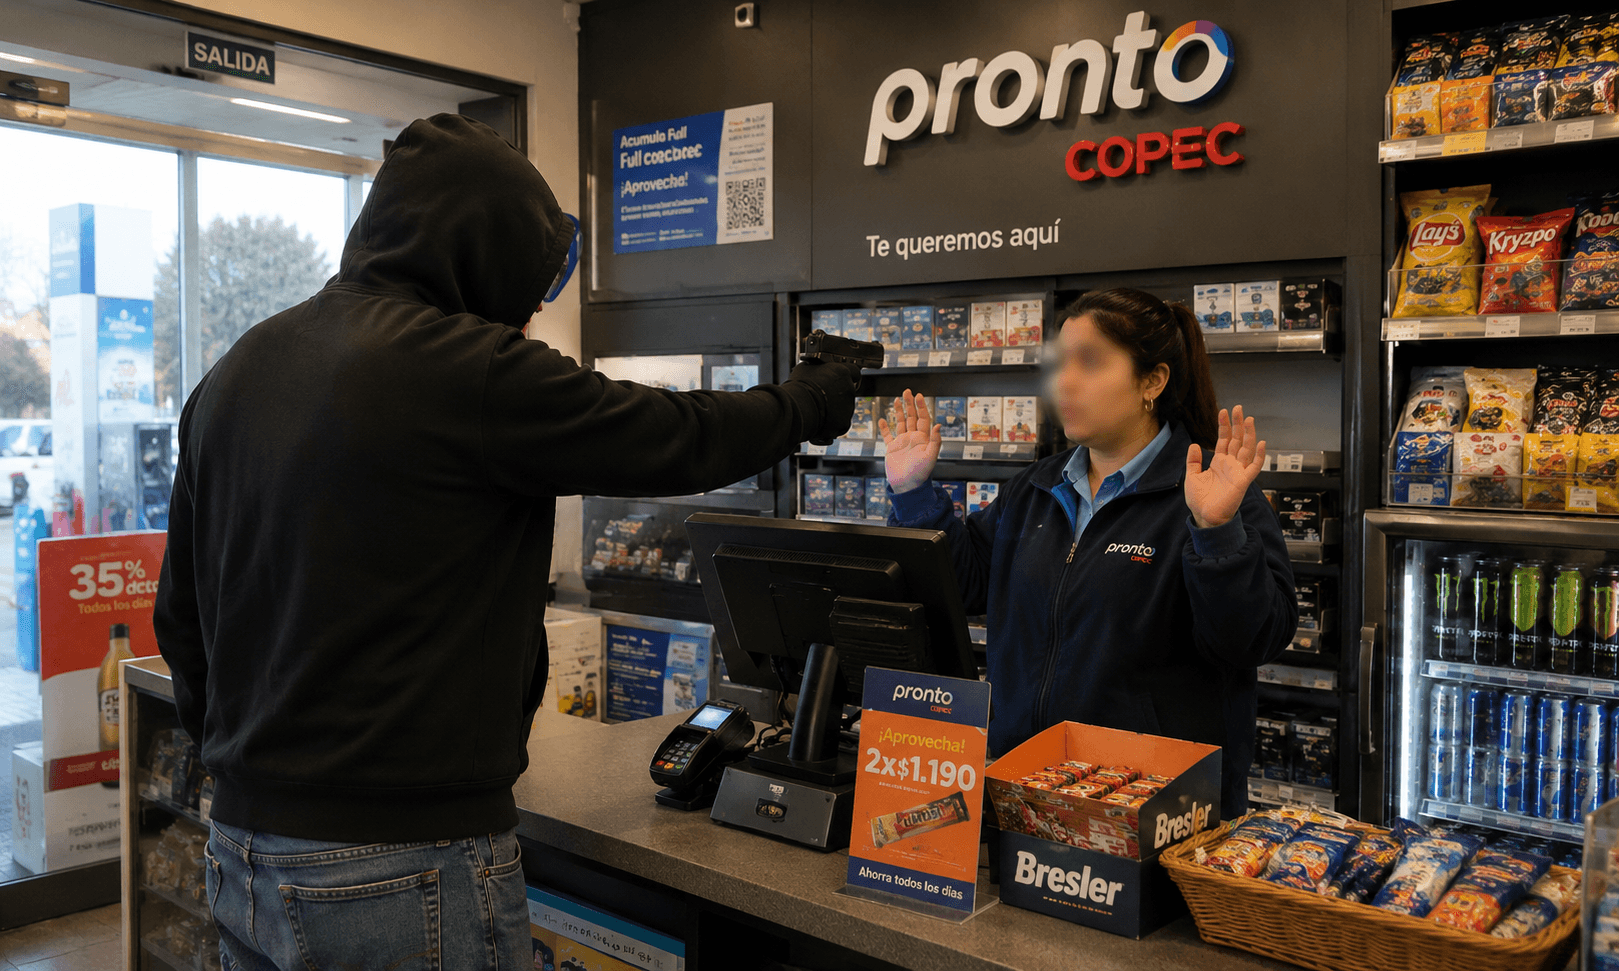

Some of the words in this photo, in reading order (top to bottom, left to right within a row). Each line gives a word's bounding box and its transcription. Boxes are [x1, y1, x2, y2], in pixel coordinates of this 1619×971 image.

[194, 42, 270, 76] SALIDA
[864, 11, 1234, 167] pronto
[620, 149, 642, 169] Full
[1065, 122, 1245, 182] COPEC
[866, 235, 890, 258] Te
[895, 226, 1003, 260] queremos
[1009, 218, 1061, 250] aquí
[1488, 228, 1557, 254] Kryzpo
[1104, 543, 1156, 557] pronto
[892, 684, 953, 705] pronto
[878, 727, 966, 754] ¡Aprovecha!
[865, 747, 976, 792] 2x$1.190
[1154, 801, 1212, 850] Bresler
[858, 866, 892, 883] Ahorra
[894, 874, 922, 890] todos
[924, 880, 940, 894] los
[1014, 850, 1123, 906] Bresler
